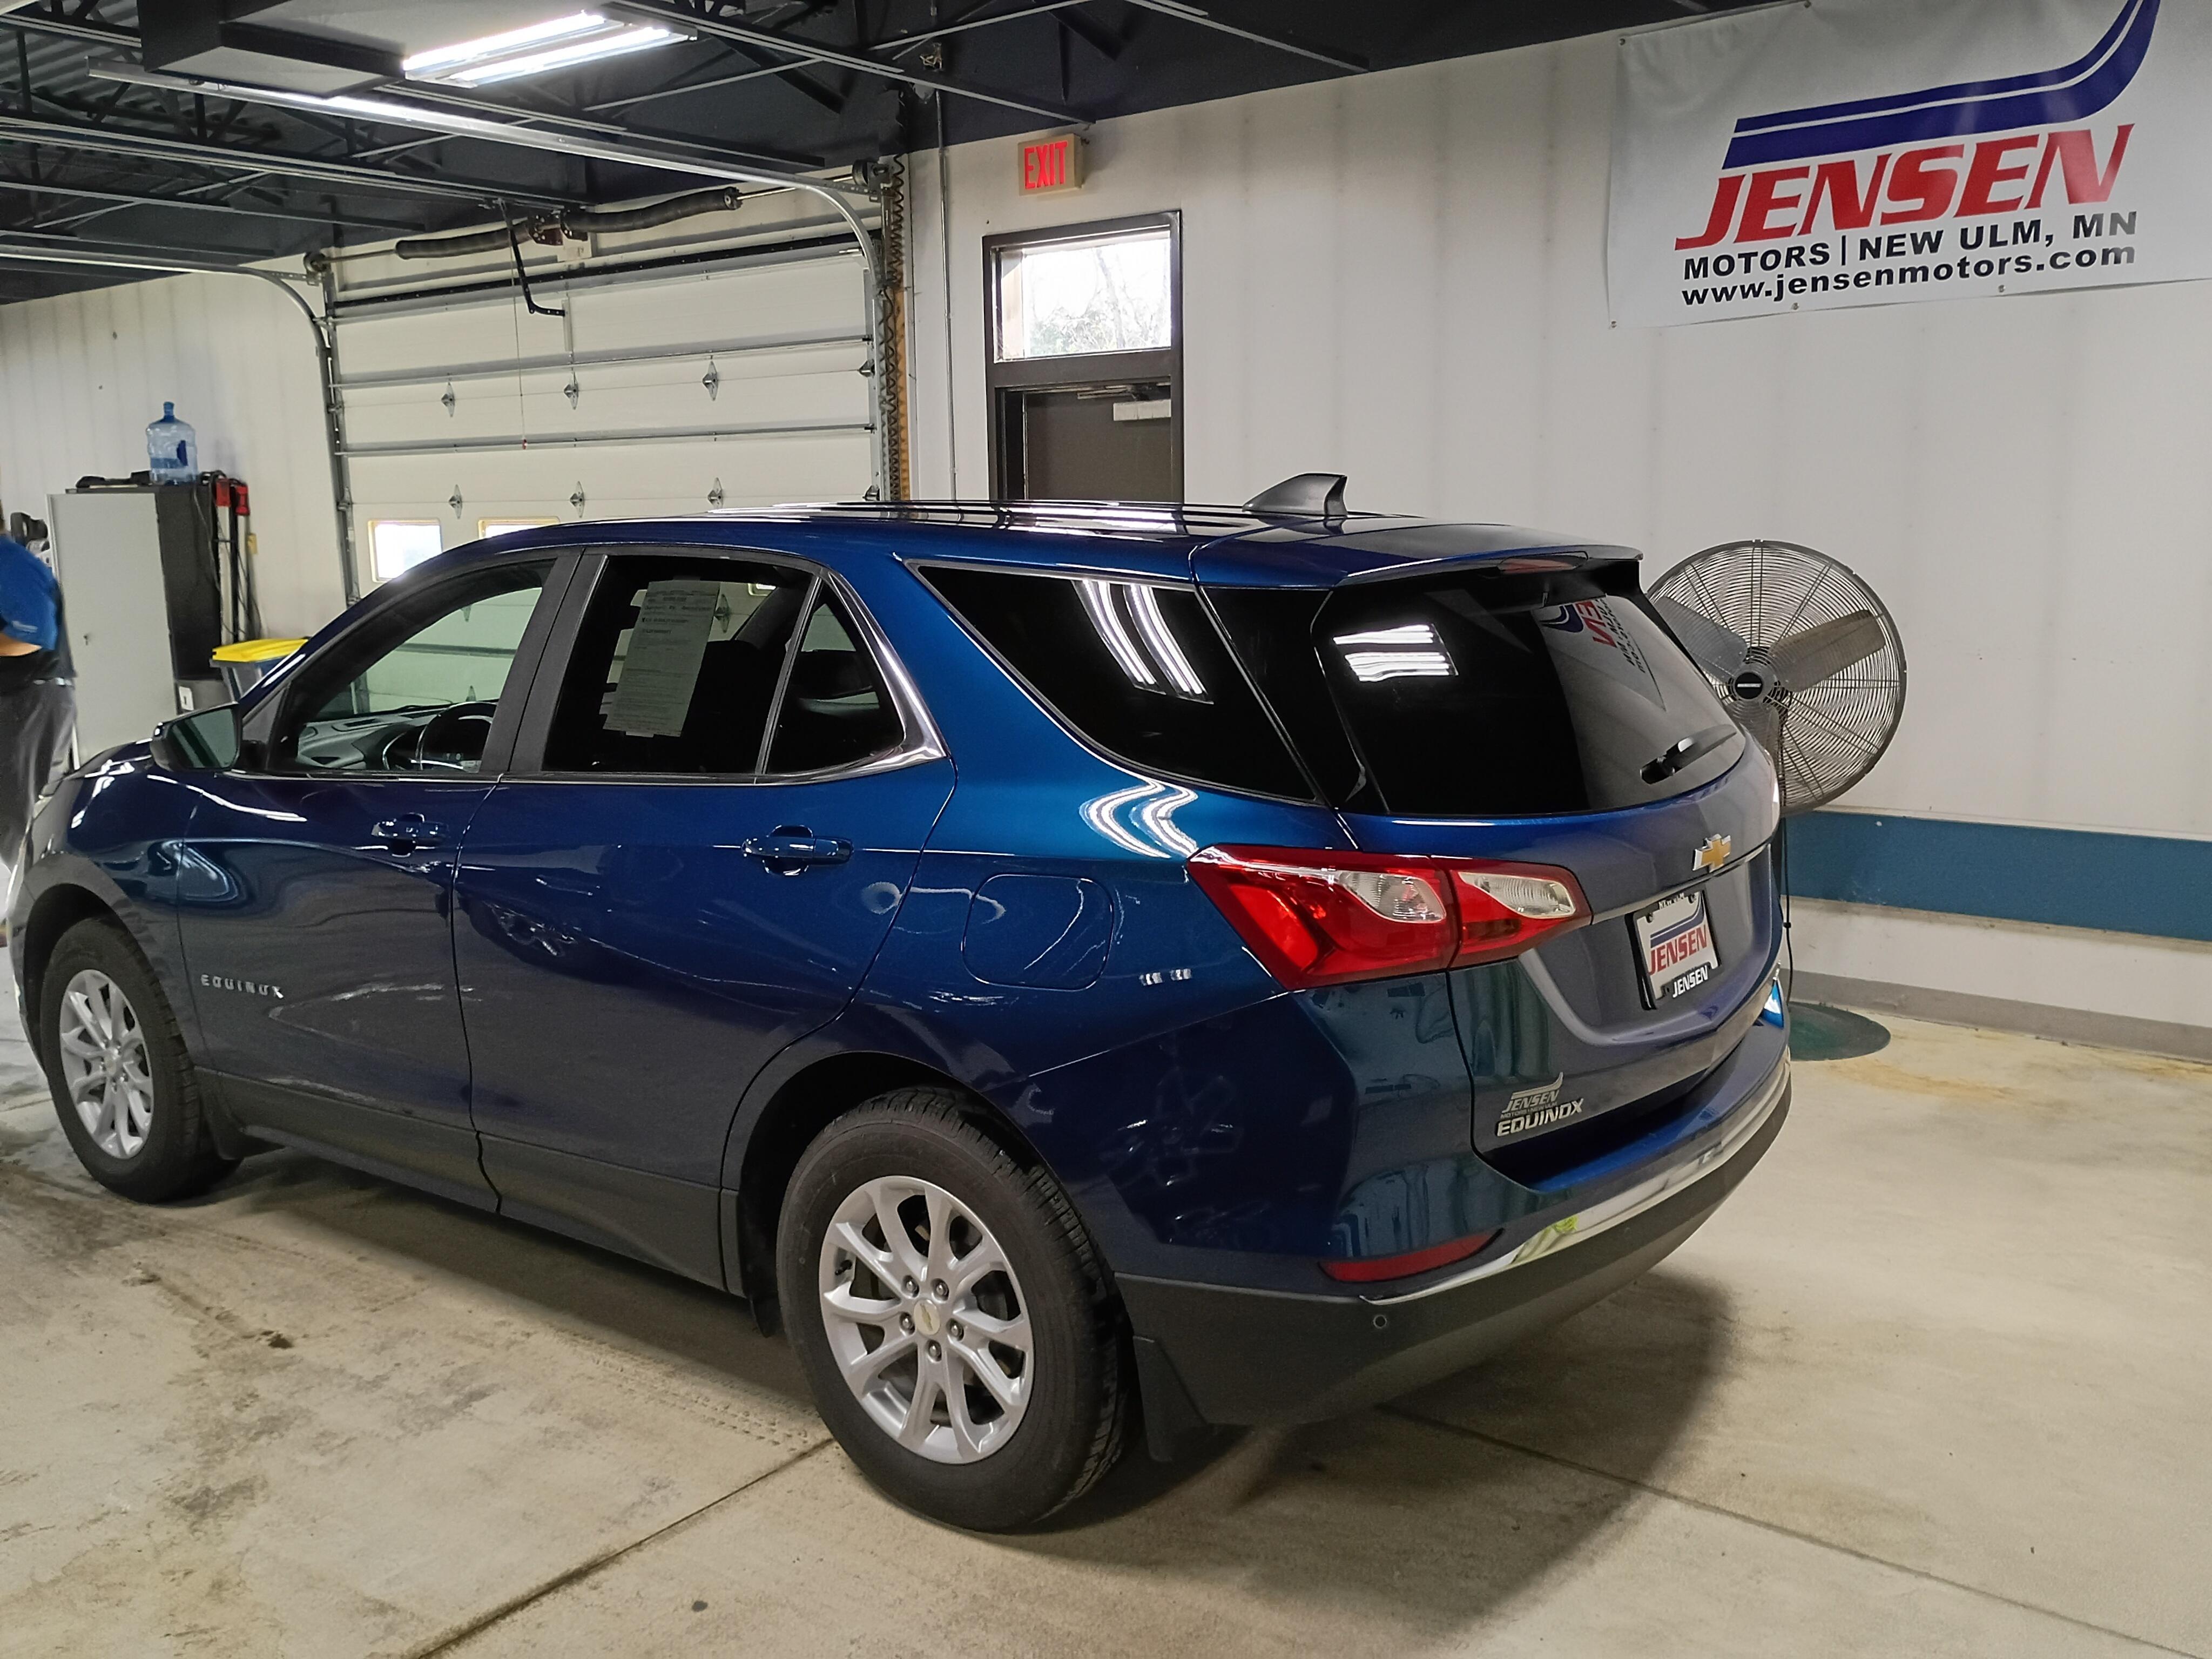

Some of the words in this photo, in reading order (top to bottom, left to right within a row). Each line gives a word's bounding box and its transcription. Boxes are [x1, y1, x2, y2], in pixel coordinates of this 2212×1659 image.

[1024, 140, 1068, 189] EXIT
[1675, 124, 2135, 251] JENSEN
[1684, 242, 1830, 280] MOTORS
[1859, 230, 1943, 261] NEW
[1960, 219, 2054, 248] ULM,
[2073, 211, 2137, 239] MN
[1682, 246, 2135, 306] www.jensenmotors.com
[1648, 924, 1708, 976] JENSEN
[1673, 965, 1709, 998] JENSEN
[1497, 1098, 1584, 1137] EQUINOX
[1500, 1109, 1527, 1120] MOTORS
[1501, 1090, 1560, 1114] JENSEN
